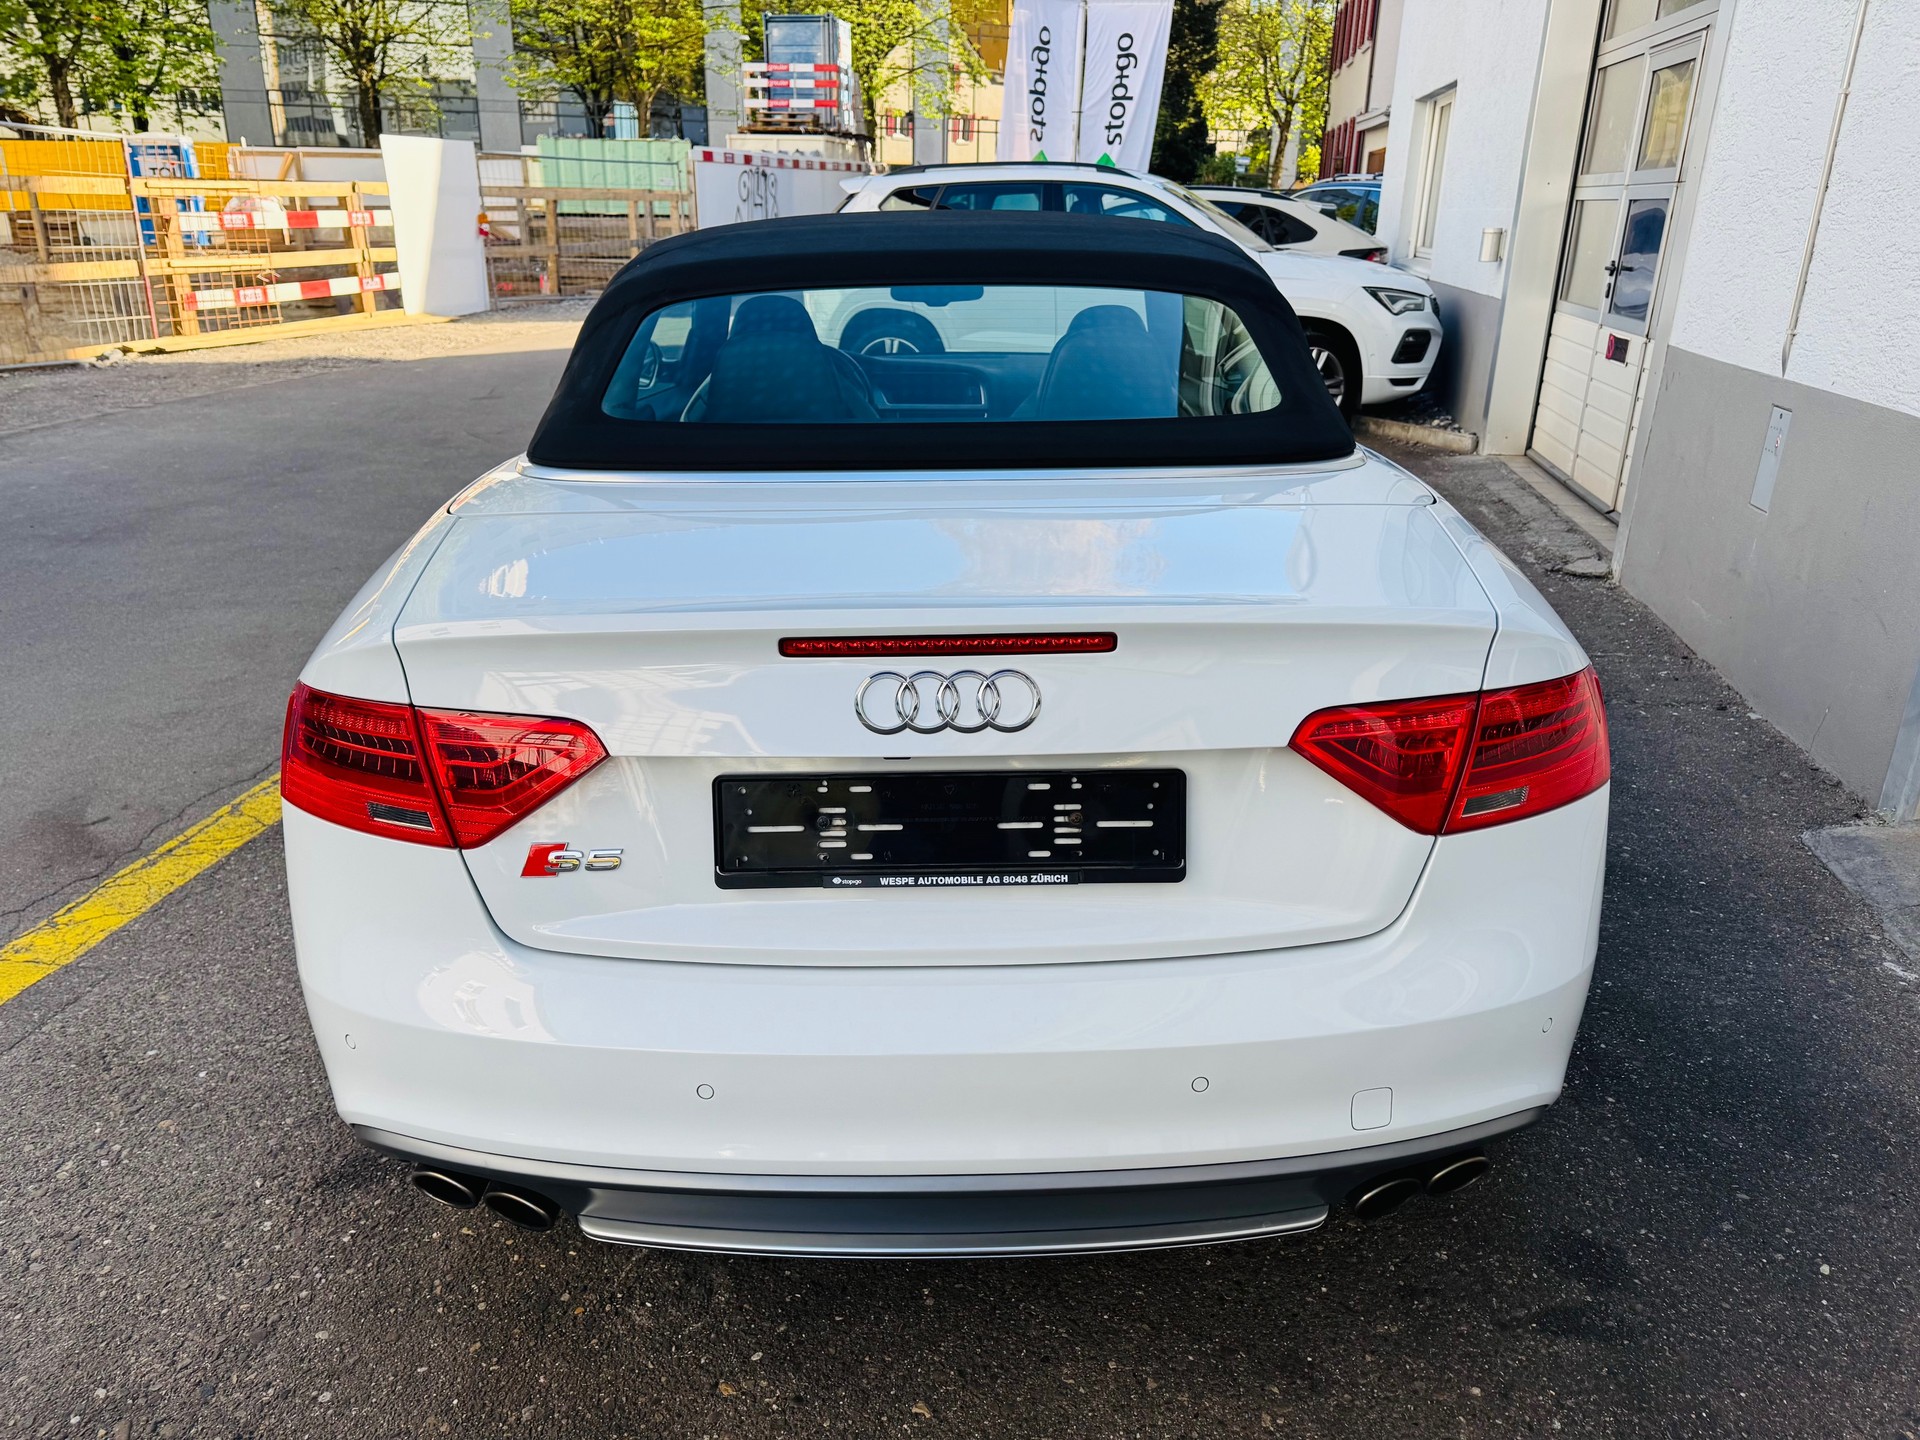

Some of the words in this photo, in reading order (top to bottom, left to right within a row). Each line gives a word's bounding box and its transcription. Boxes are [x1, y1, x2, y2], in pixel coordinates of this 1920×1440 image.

[1104, 32, 1138, 145] stop+go
[543, 847, 625, 873] S5
[879, 876, 915, 886] WESPE
[917, 875, 983, 885] AUTOMOBILE
[985, 875, 1001, 884] AG
[1003, 875, 1028, 884] 8048
[1030, 873, 1069, 883] ZÜRICH
